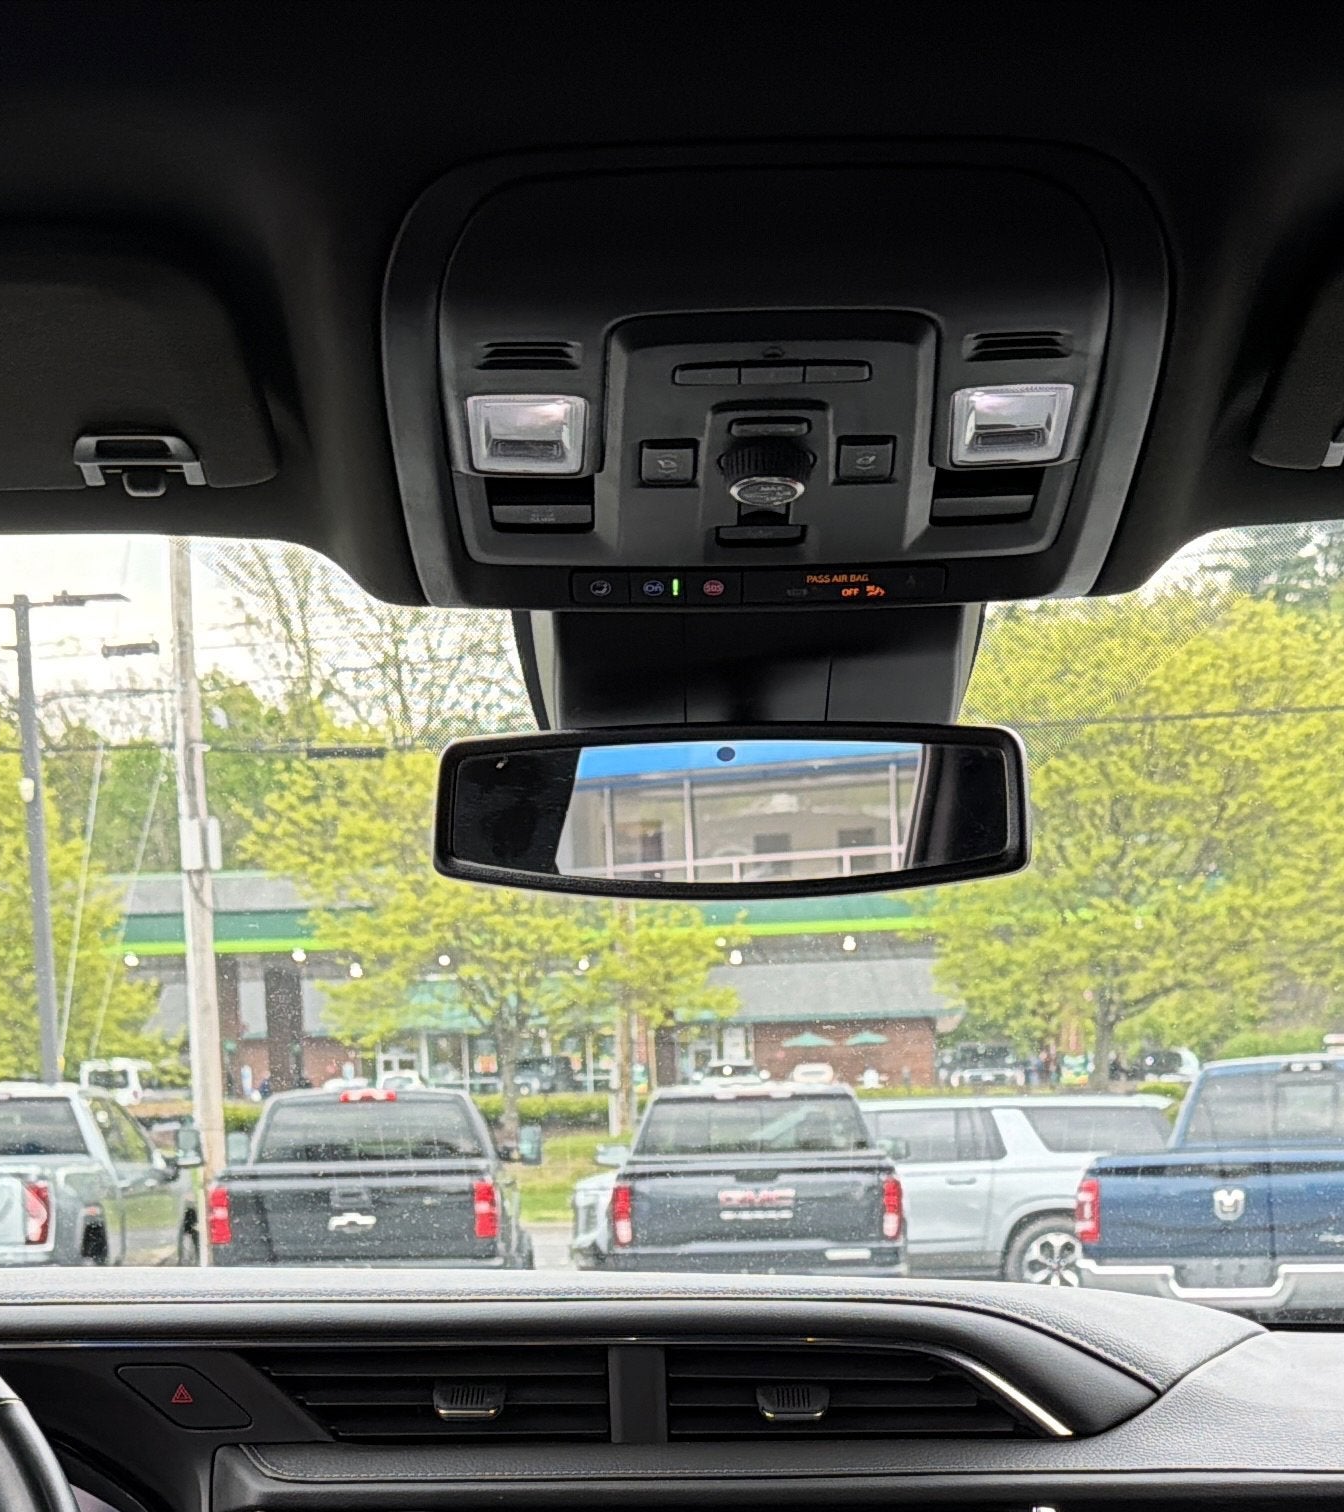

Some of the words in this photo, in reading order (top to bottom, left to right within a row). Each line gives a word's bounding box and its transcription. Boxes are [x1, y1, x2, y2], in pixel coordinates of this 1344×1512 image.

[806, 575, 830, 583] PASS
[832, 574, 848, 582] AIR
[841, 588, 860, 597] OFF
